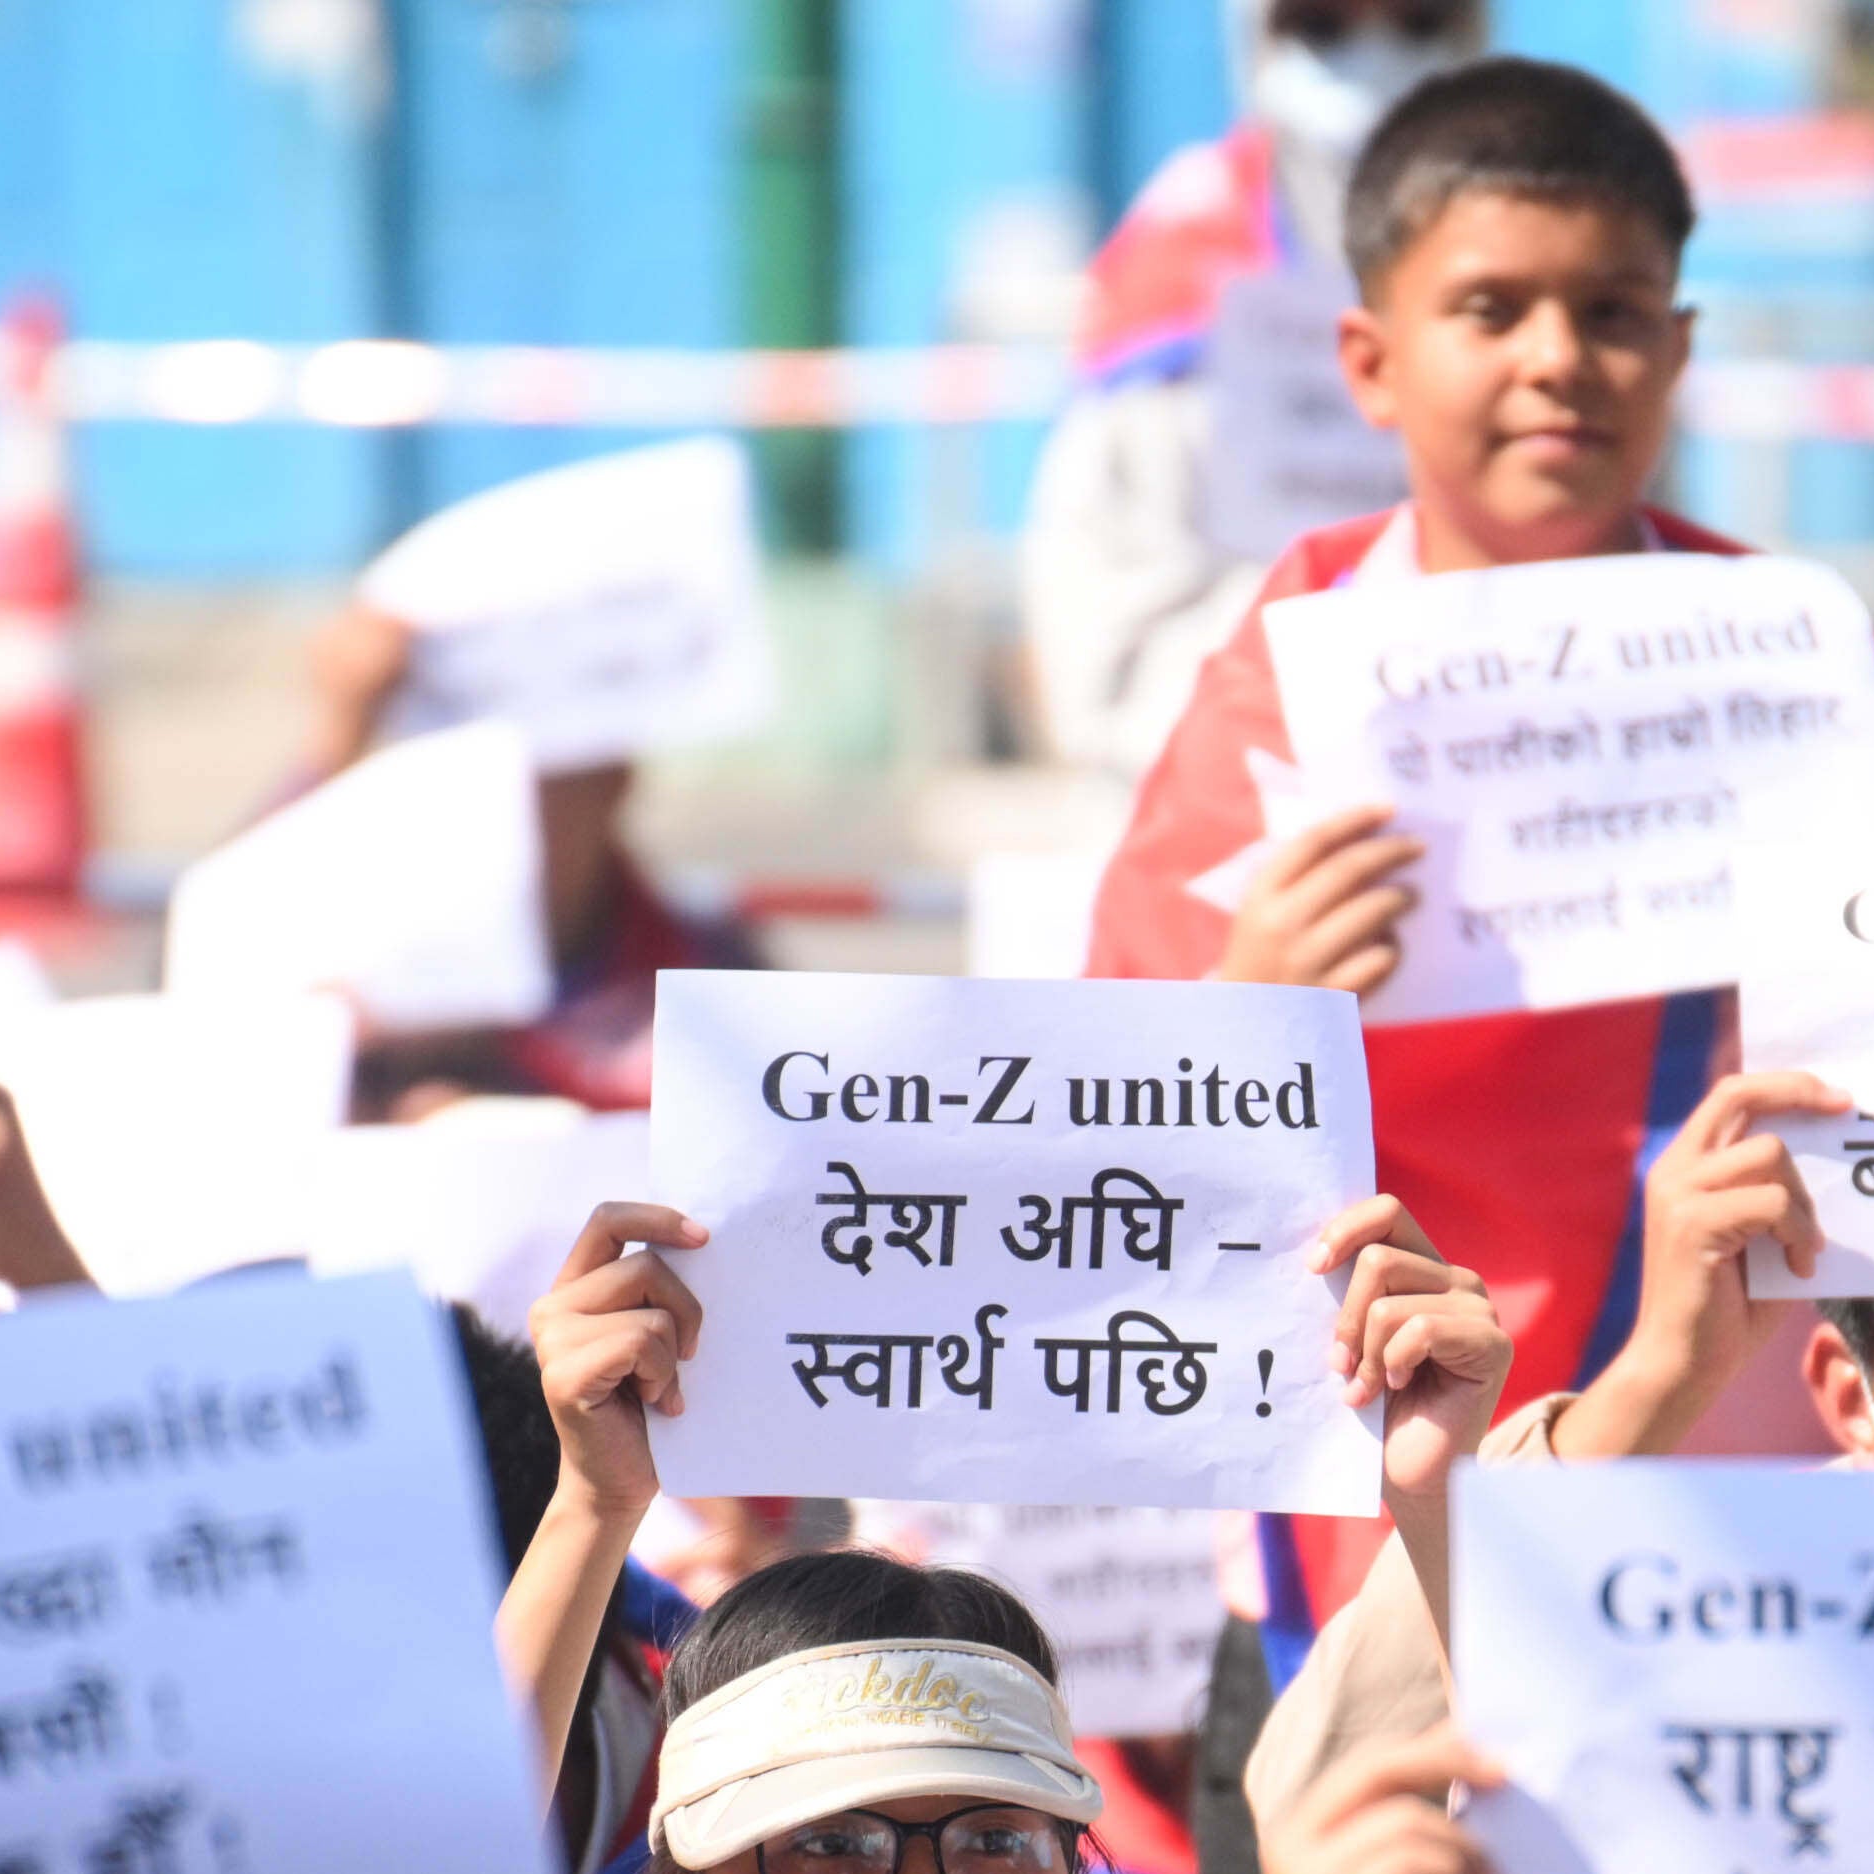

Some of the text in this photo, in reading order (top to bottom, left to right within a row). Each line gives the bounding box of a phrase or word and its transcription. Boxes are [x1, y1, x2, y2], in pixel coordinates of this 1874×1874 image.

[1375, 610, 1821, 704] Gen-Z united
[762, 1050, 1321, 1130] Gen-Z united
[815, 1161, 967, 1277] देश
[999, 1167, 1184, 1272] अघि
[786, 1304, 1275, 1418] स्वार्थ पछि !
[5, 1350, 365, 1495] united
[1663, 1721, 1840, 1855] राष्ट्र
